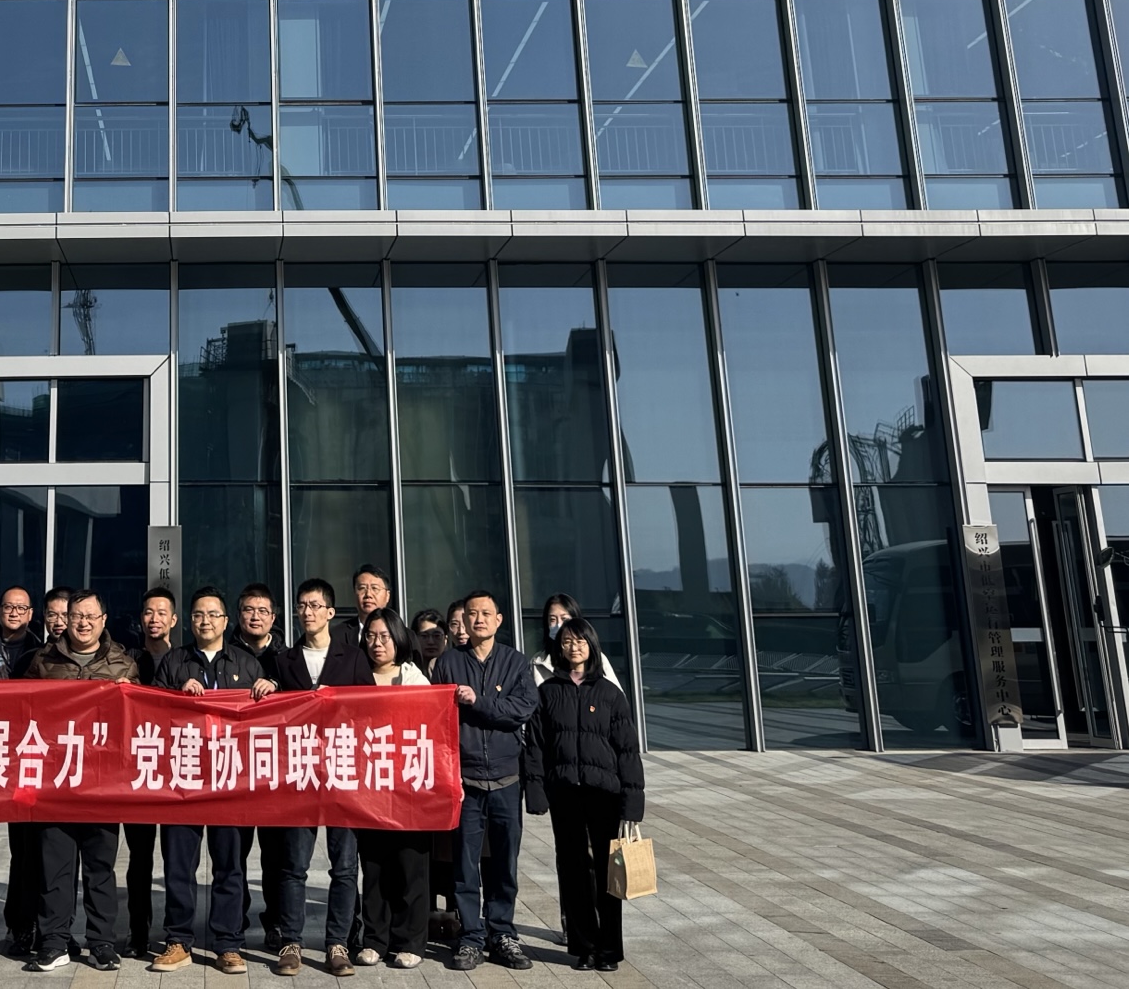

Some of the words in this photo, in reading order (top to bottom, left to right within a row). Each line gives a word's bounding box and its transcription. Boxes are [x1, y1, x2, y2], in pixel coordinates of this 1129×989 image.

[130, 721, 435, 791] 党建协同联建活动
